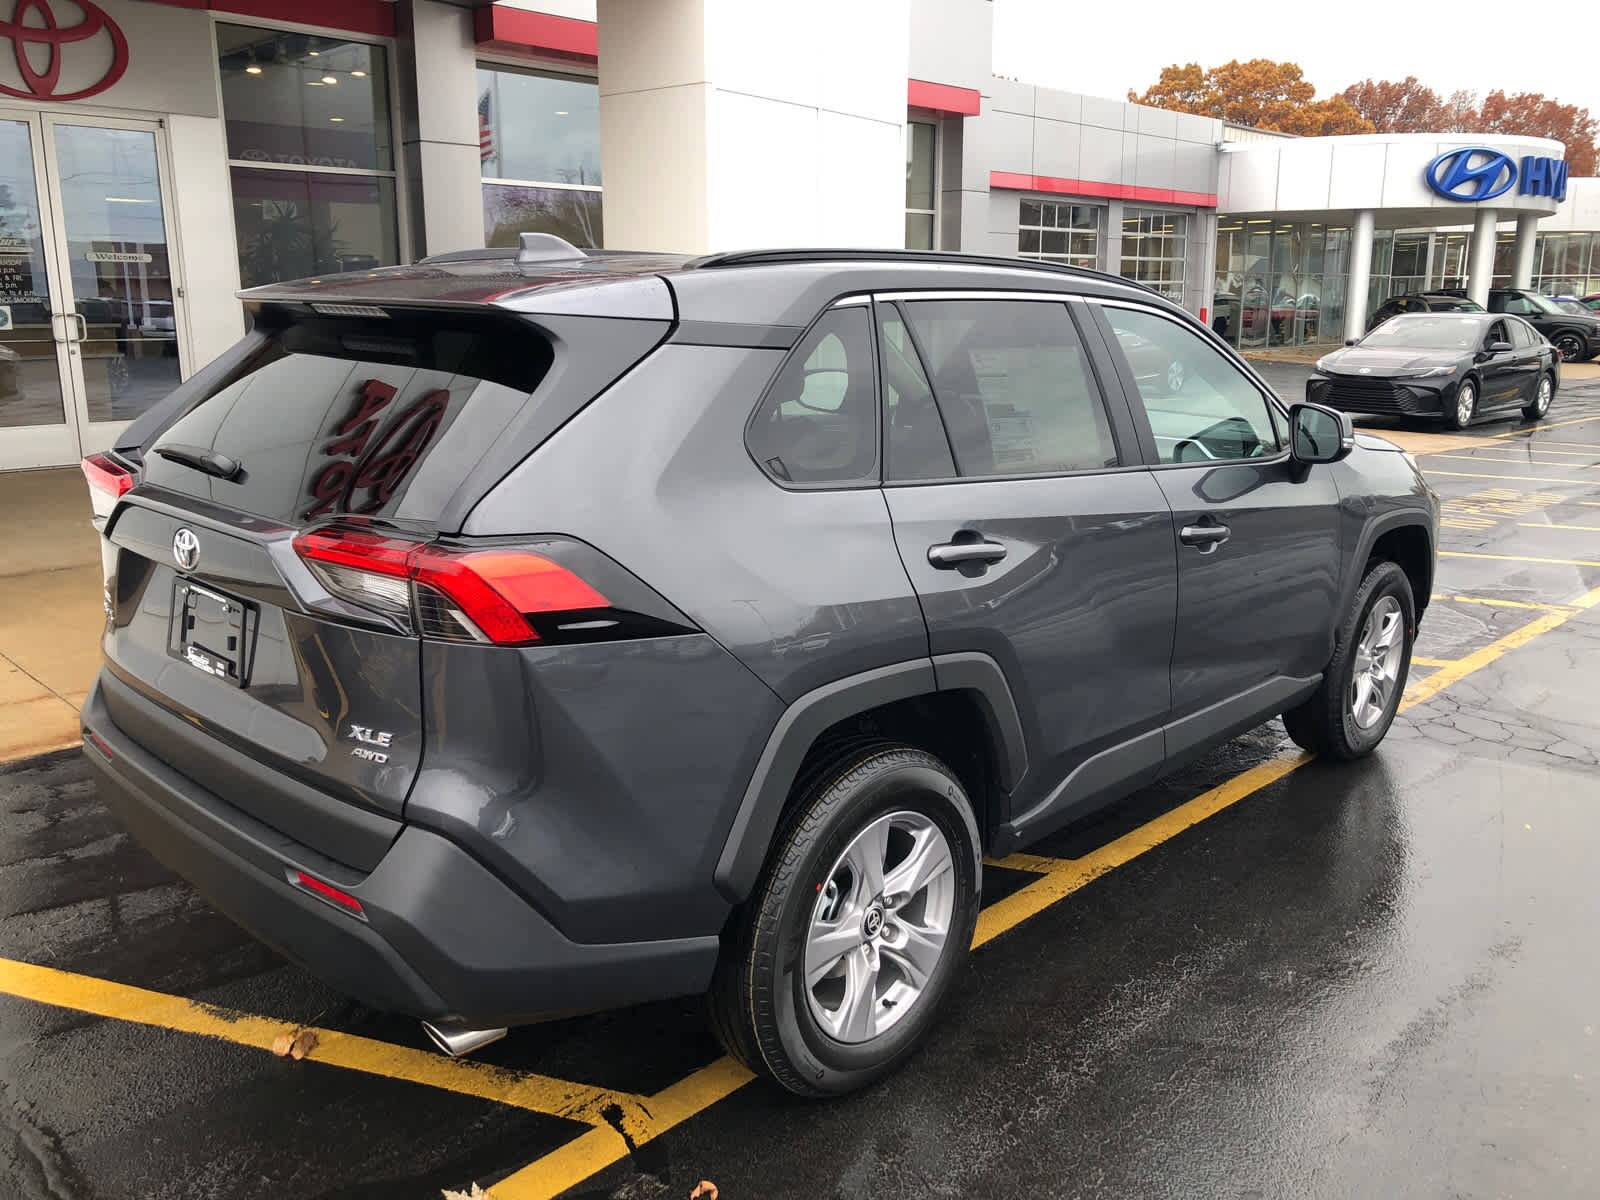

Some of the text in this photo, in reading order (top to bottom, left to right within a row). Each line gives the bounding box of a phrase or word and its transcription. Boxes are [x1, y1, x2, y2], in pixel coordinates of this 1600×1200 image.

[95, 252, 145, 262] Welcome
[348, 724, 393, 748] XLE
[351, 747, 388, 764] AWD
